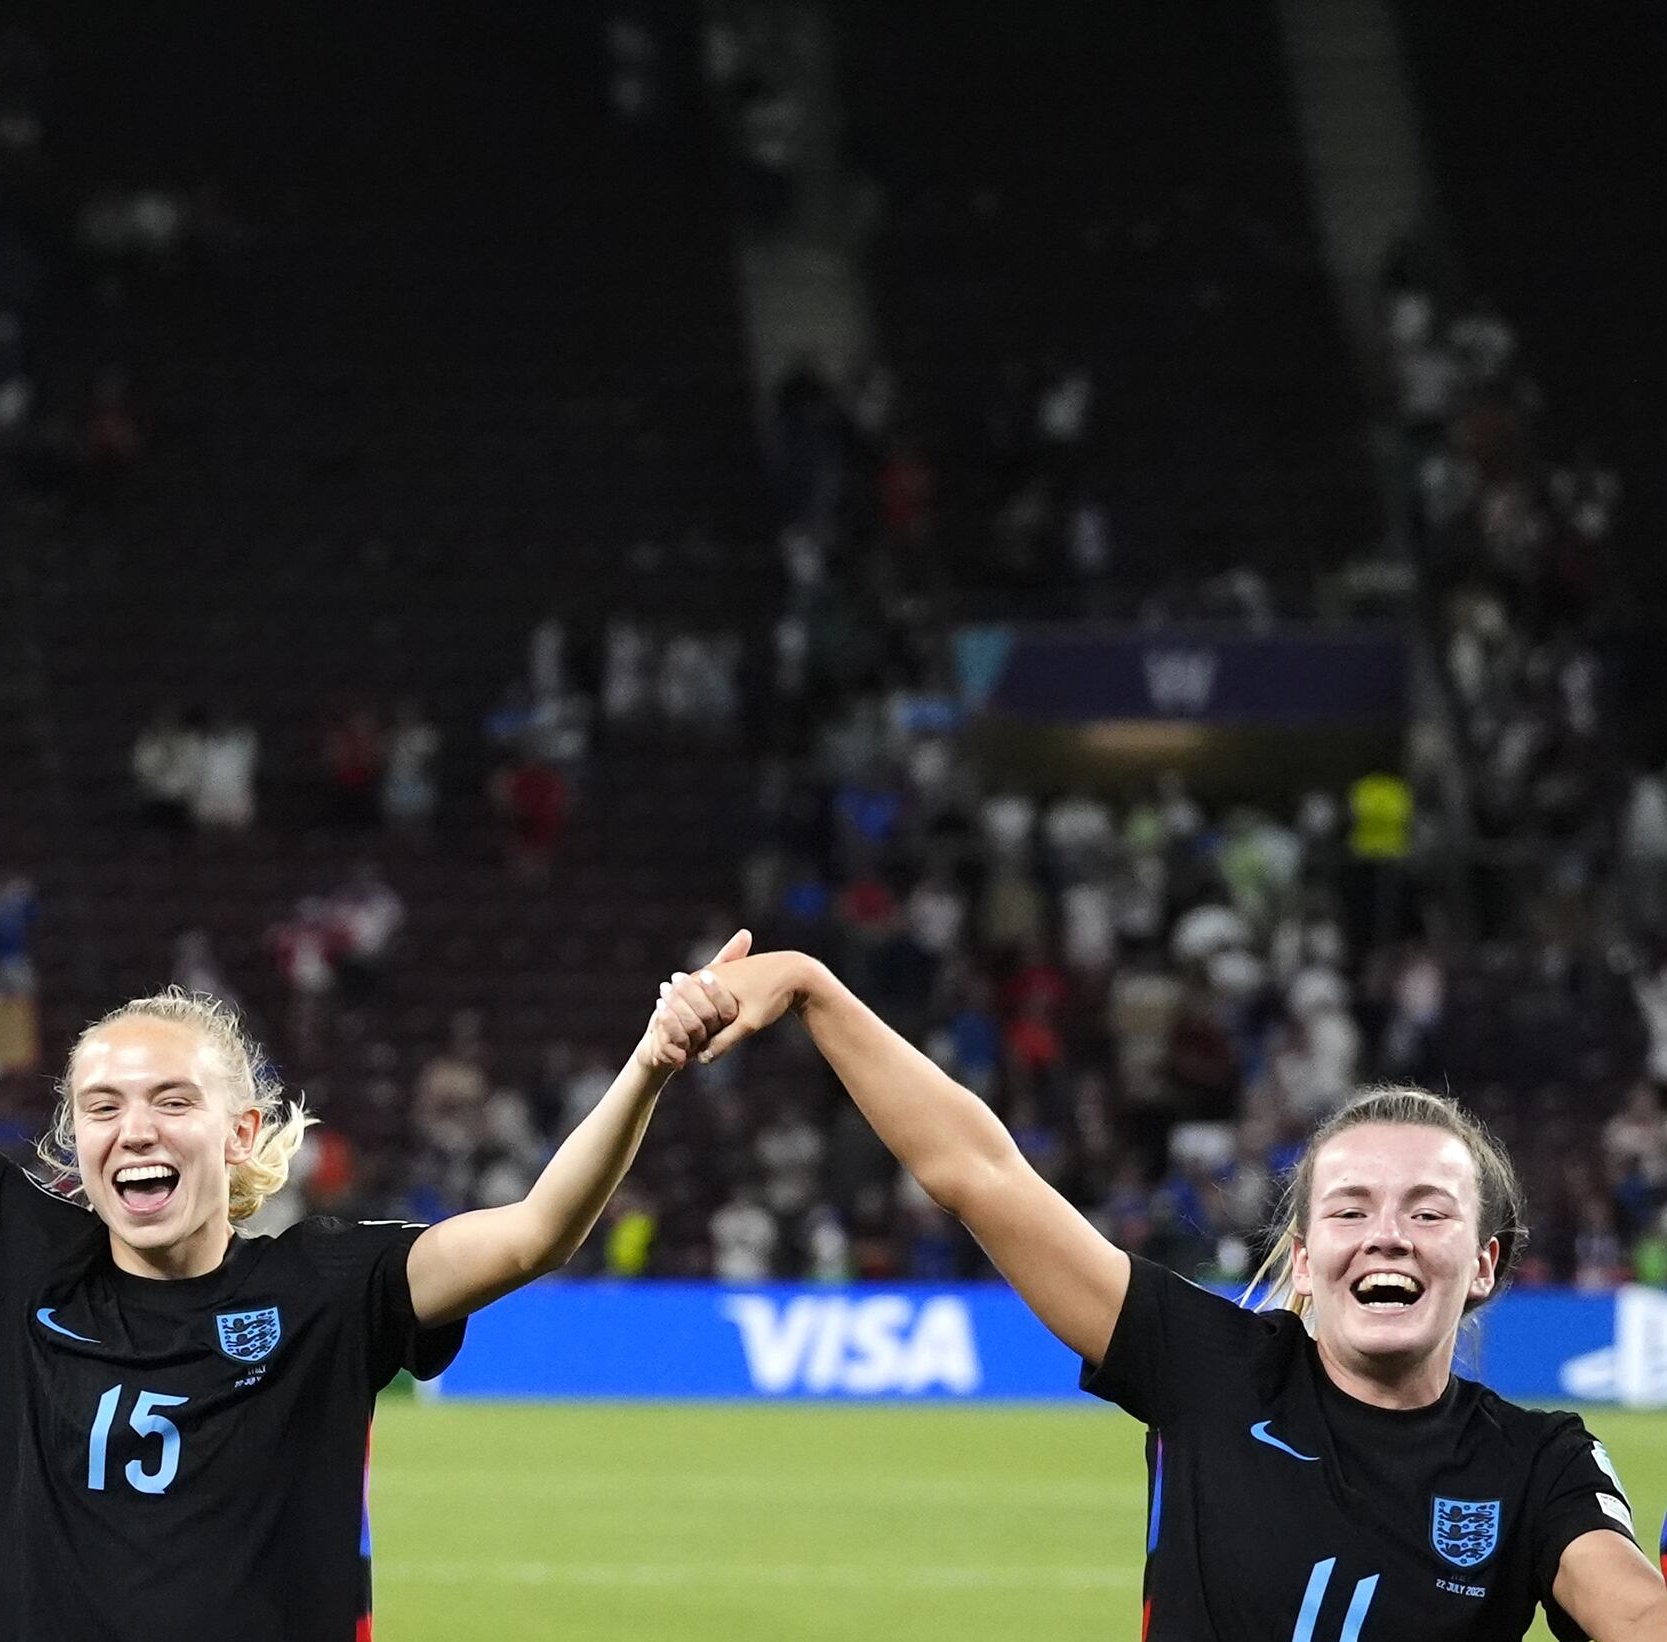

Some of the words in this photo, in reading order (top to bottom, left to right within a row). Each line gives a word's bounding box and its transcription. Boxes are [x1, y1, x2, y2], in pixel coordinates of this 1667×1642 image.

[723, 1293, 982, 1395] VISA
[87, 1384, 189, 1495] 15
[1435, 1578, 1447, 1590] 22
[1446, 1582, 1467, 1595] JULY
[1465, 1585, 1487, 1598] 2025
